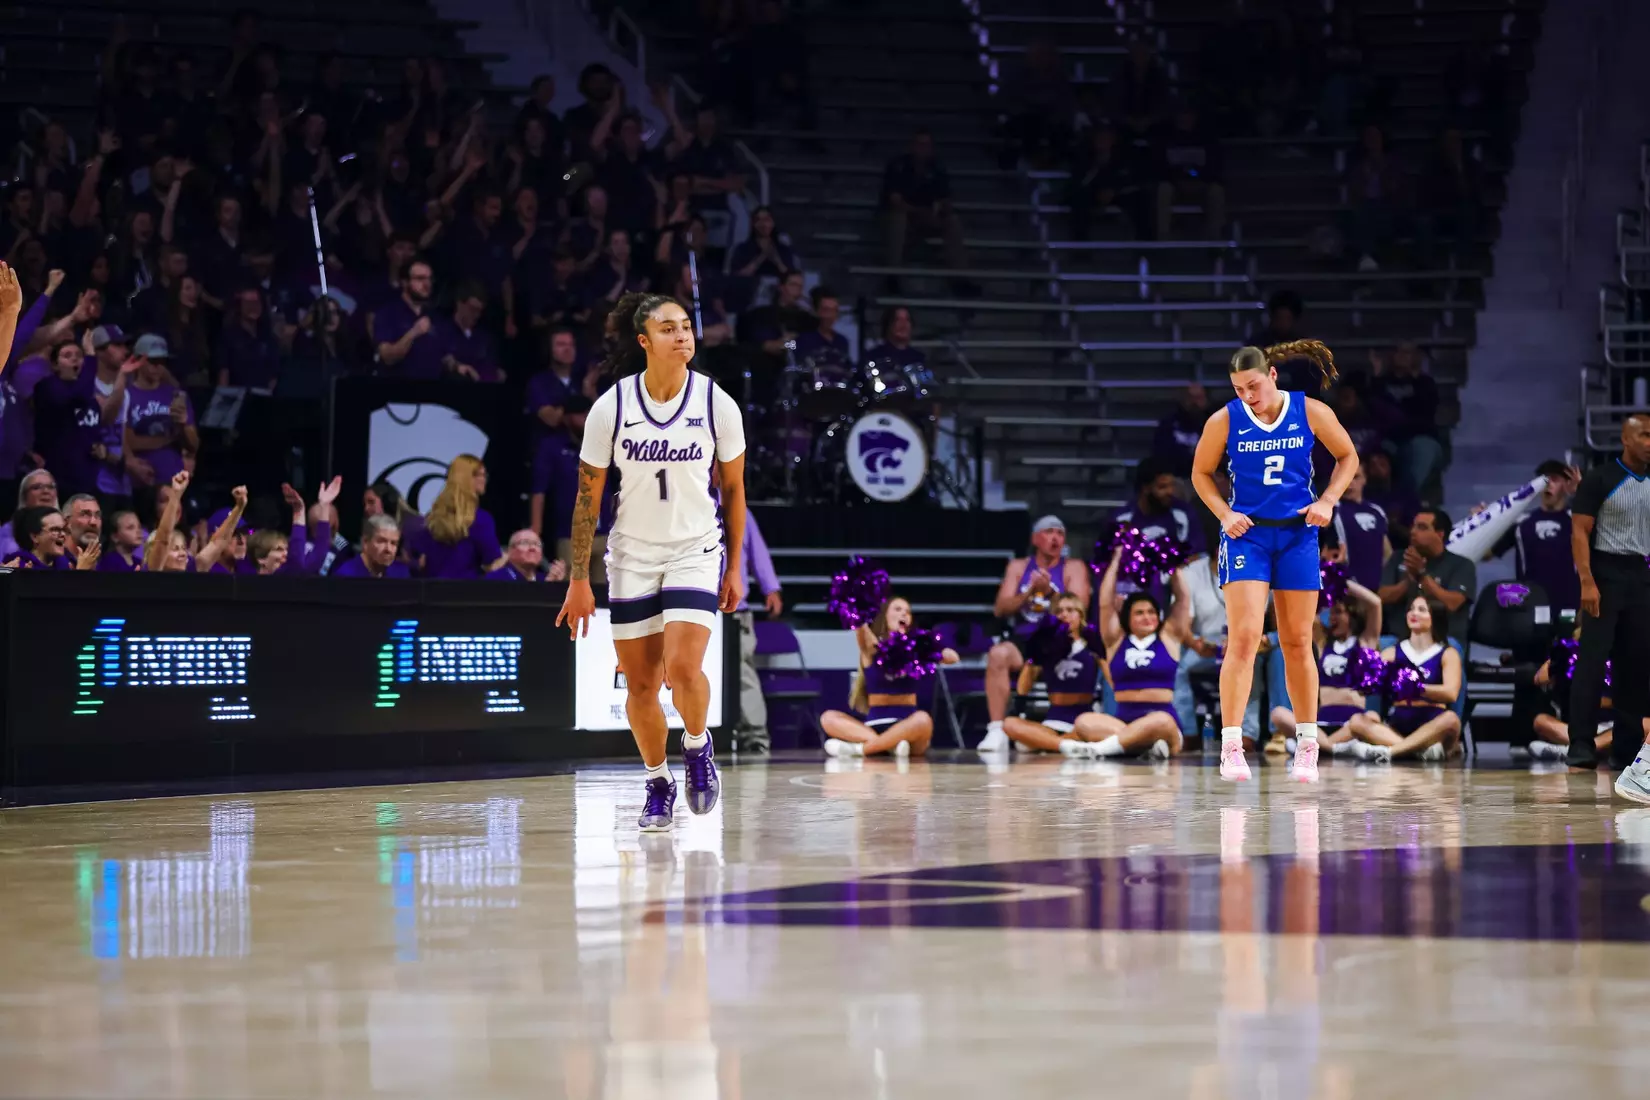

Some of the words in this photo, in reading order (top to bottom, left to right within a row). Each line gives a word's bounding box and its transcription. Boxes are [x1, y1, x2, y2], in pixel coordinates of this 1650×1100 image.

[621, 438, 703, 461] Wildcats
[1237, 436, 1304, 452] CREIGHTON
[1263, 455, 1285, 486] 2
[655, 468, 669, 502] 1
